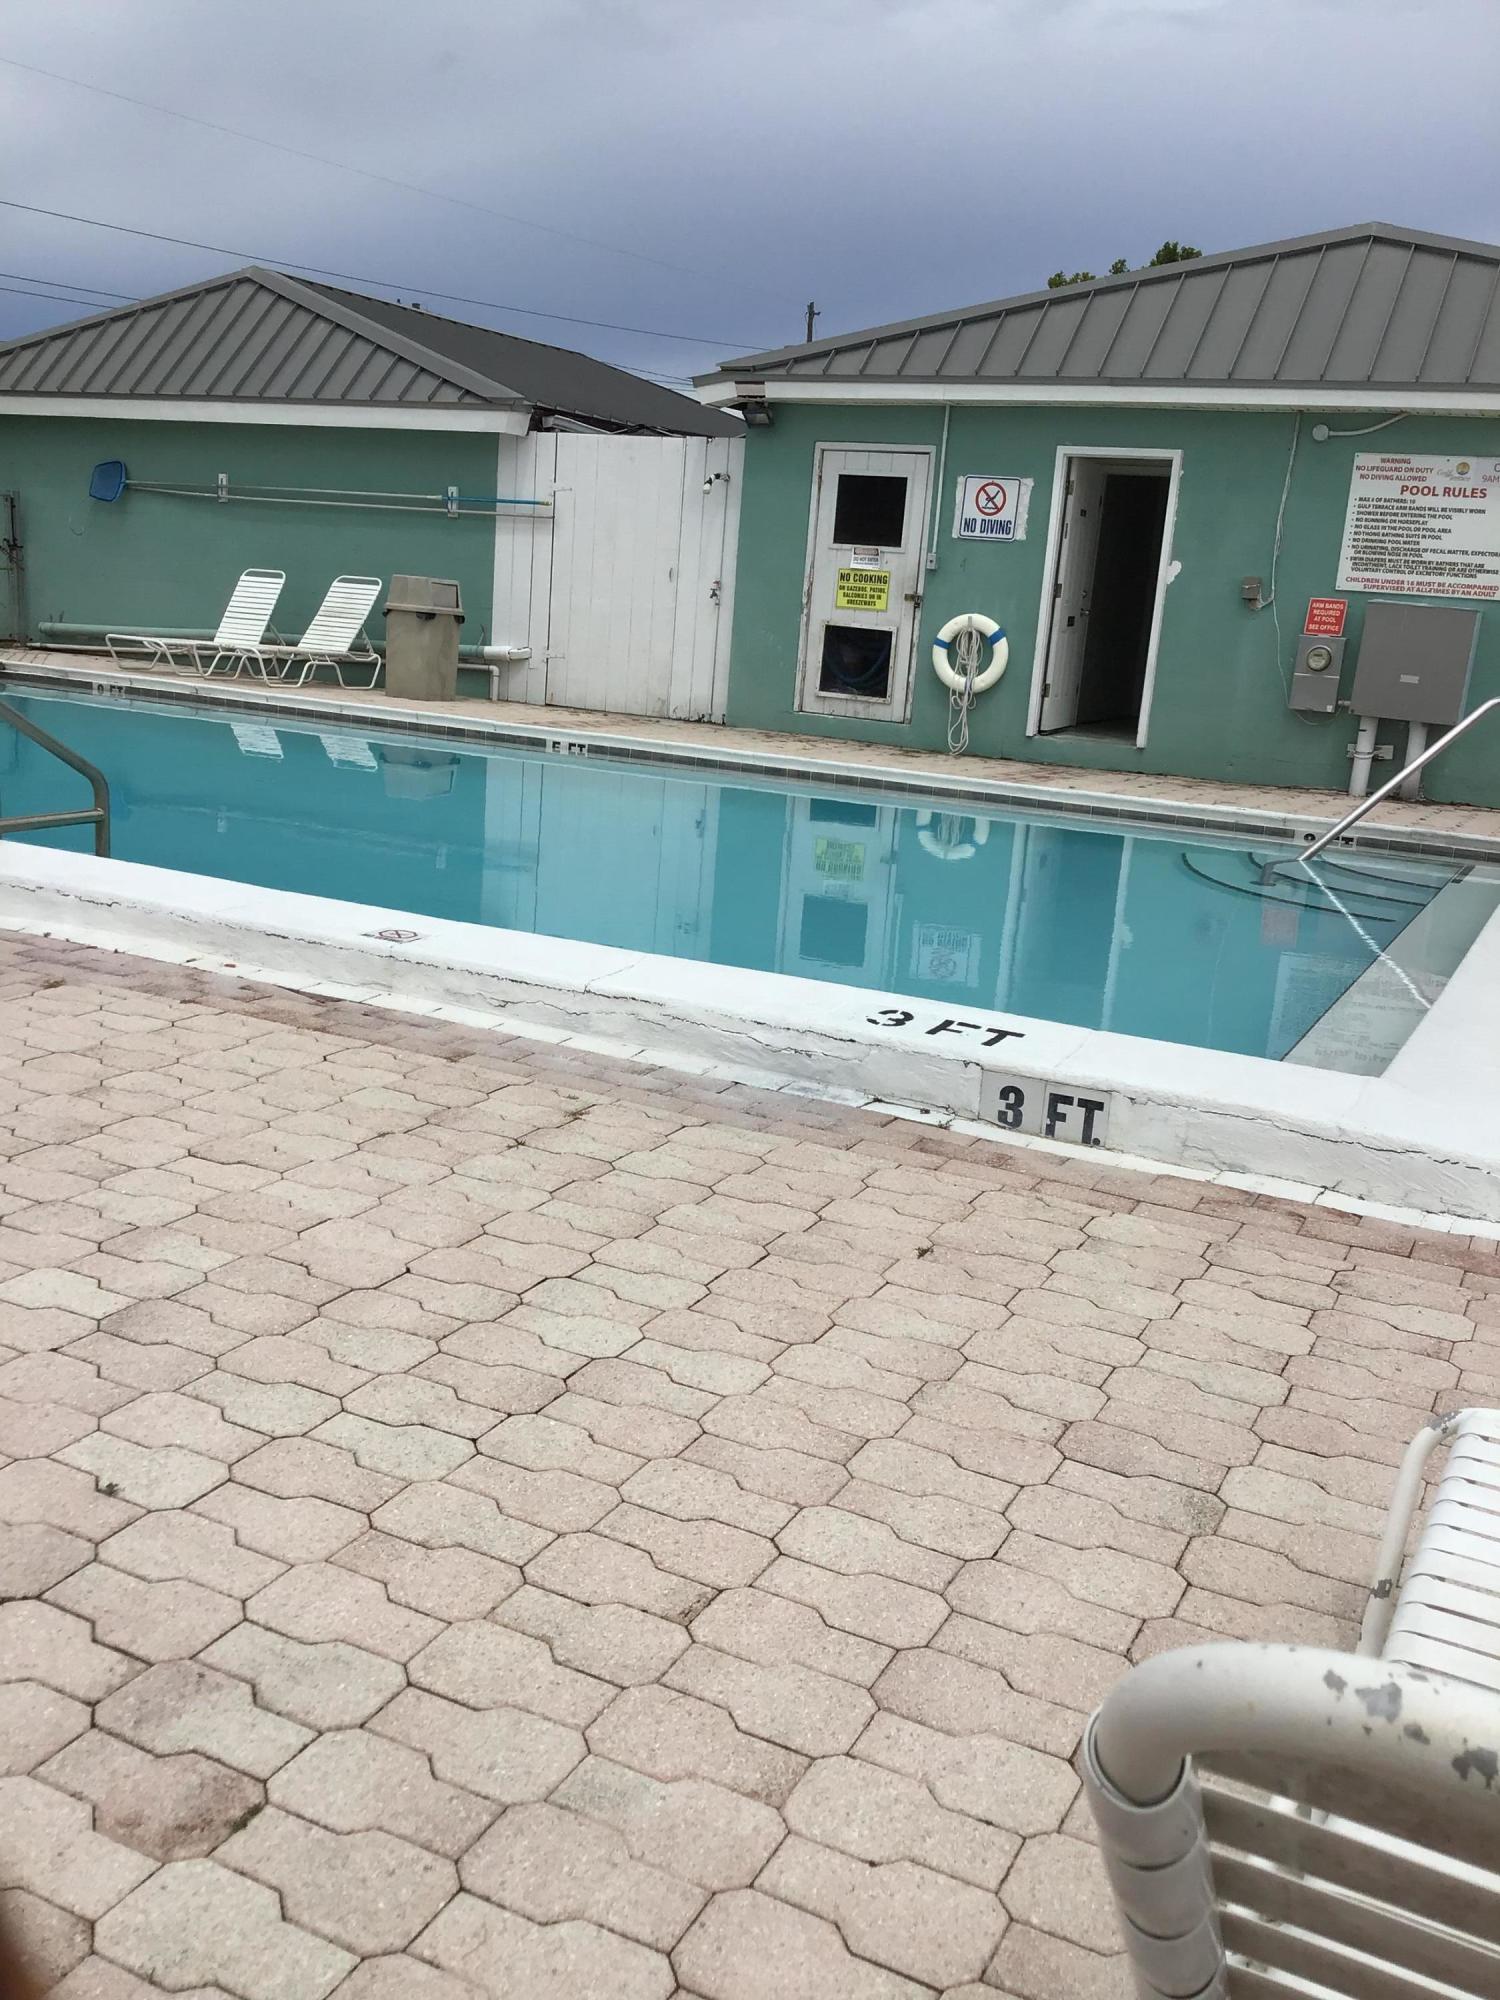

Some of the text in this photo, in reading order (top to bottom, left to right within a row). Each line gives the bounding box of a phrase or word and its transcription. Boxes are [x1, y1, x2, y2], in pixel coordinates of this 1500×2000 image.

[1400, 485, 1487, 498] POOL RULES
[963, 517, 1012, 535] NO DIVING
[840, 572, 888, 584] NO COOKING
[1363, 584, 1405, 592] SUPERVISED
[1448, 583, 1499, 591] ACCOMPANIED
[866, 1009, 1026, 1047] 3 FT
[997, 1085, 1105, 1146] 3 FT.
